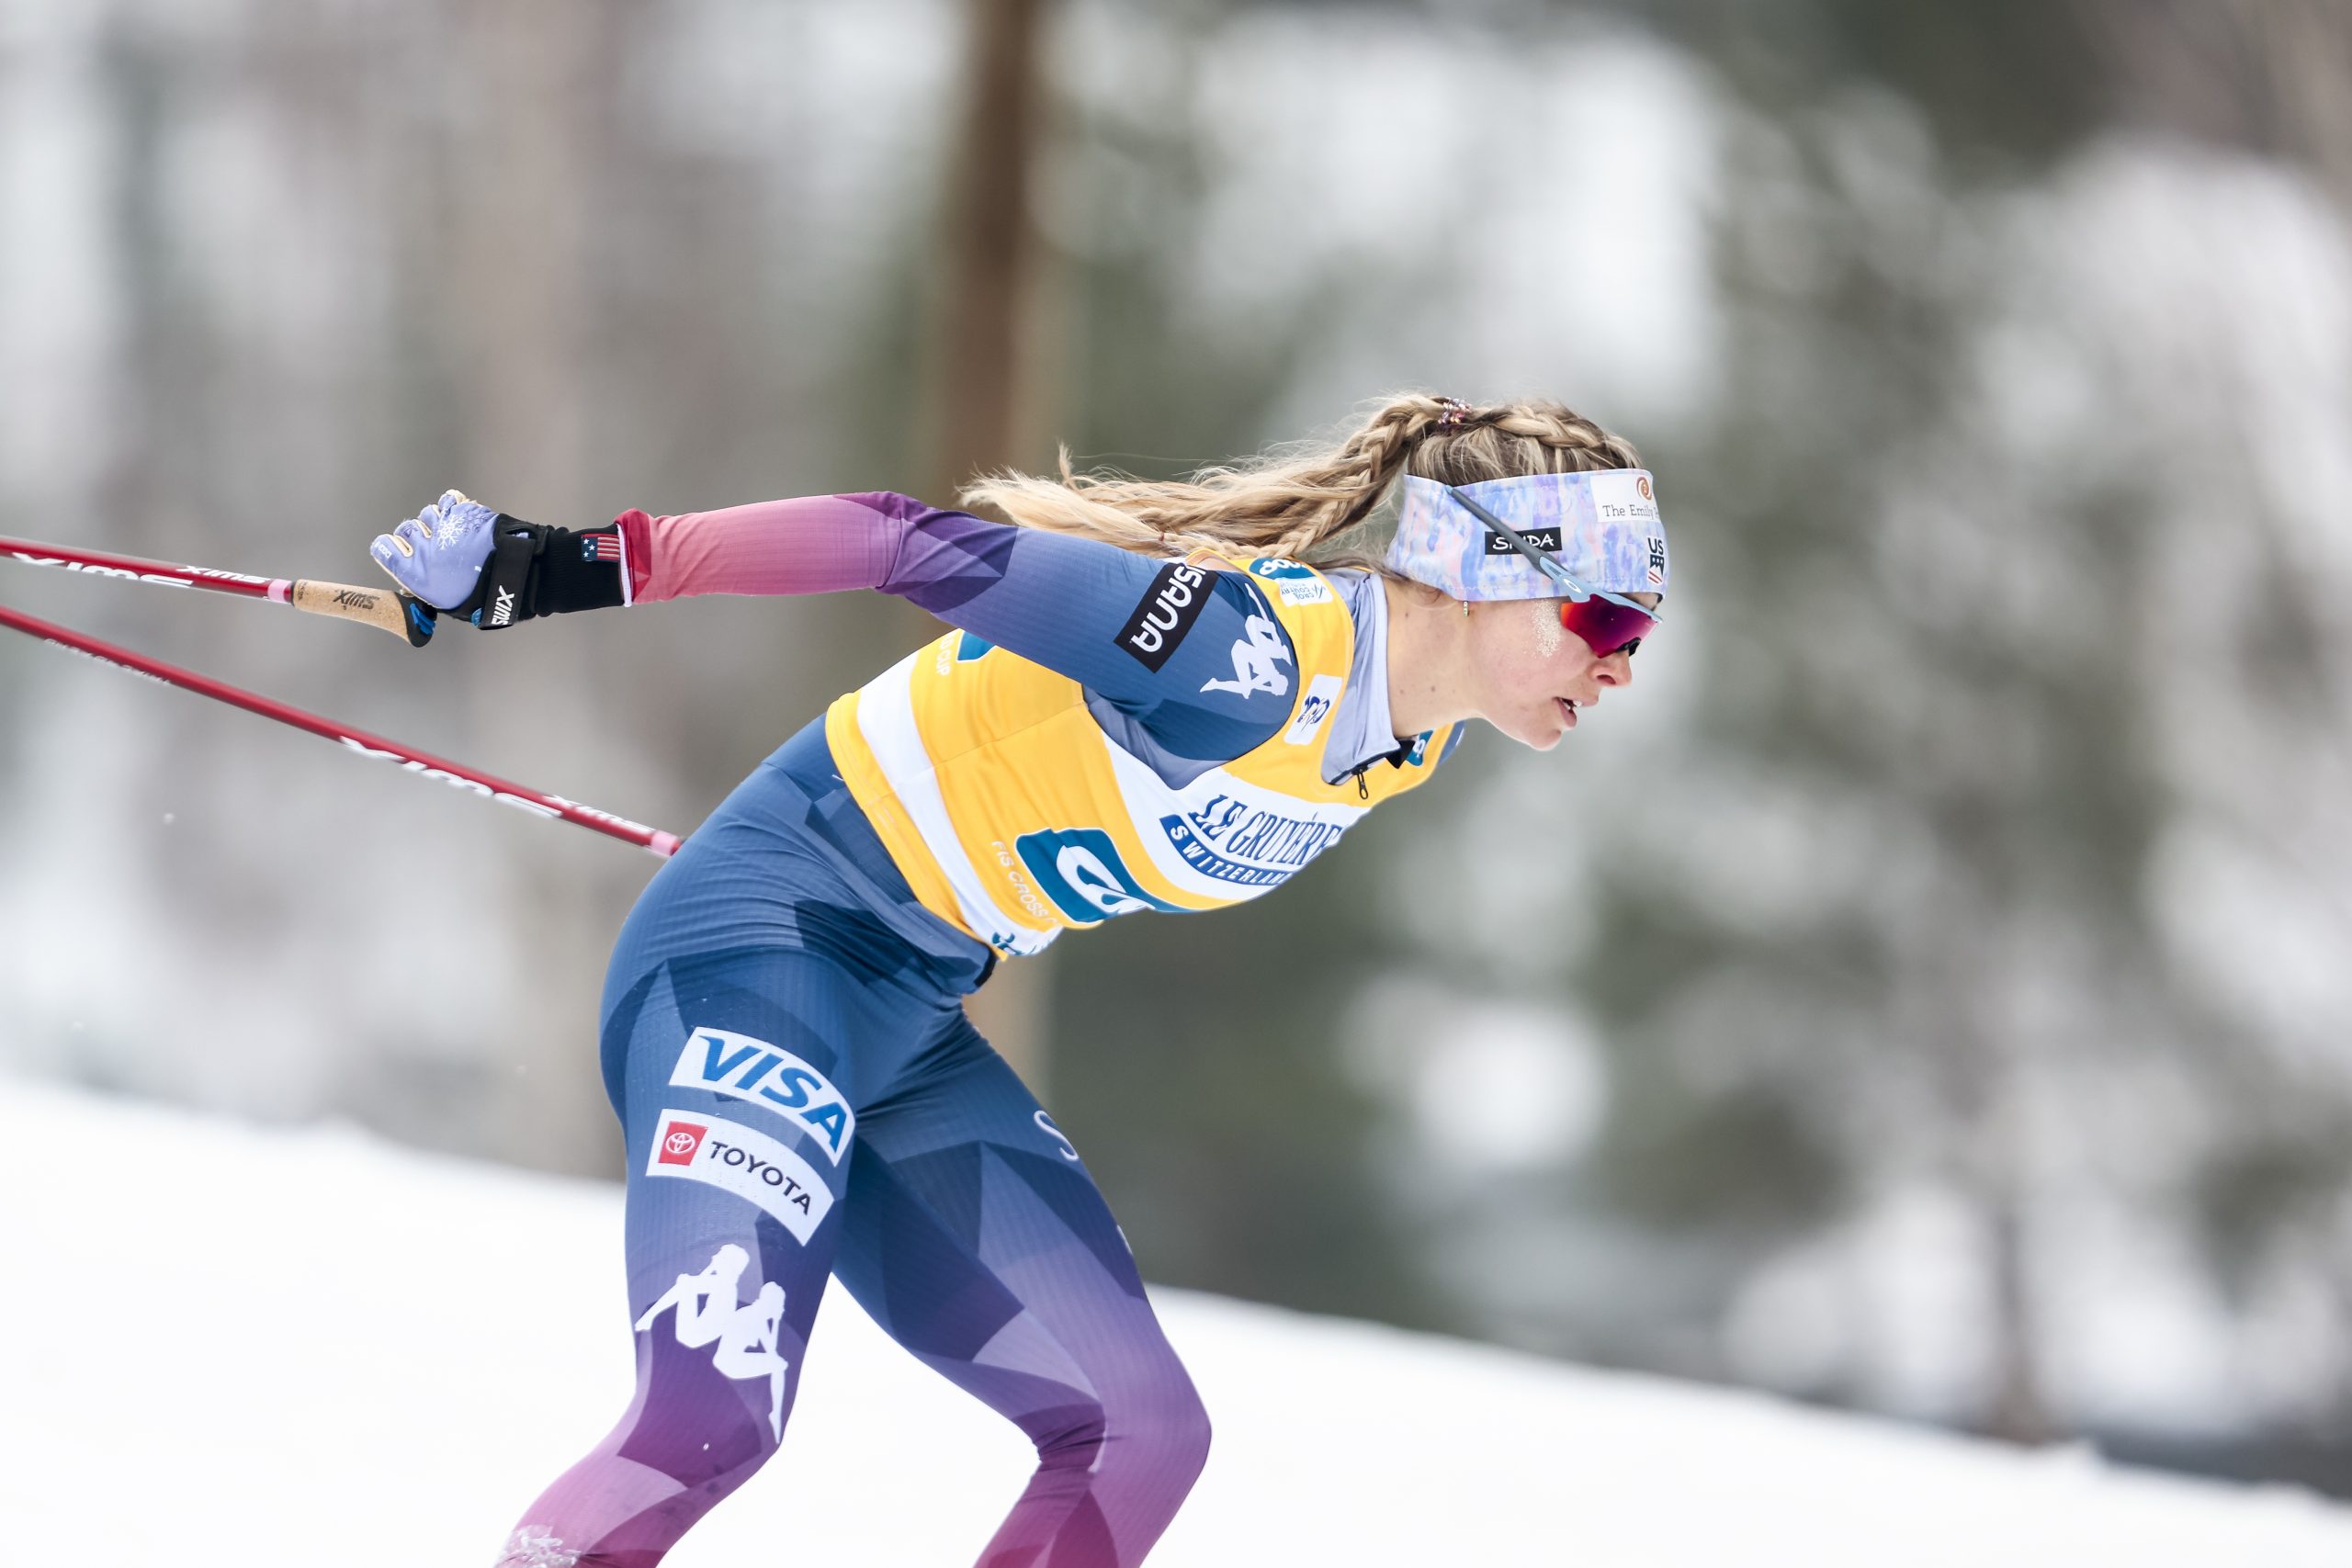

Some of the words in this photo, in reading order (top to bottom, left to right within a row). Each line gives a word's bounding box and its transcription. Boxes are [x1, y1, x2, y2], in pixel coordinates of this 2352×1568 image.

[1601, 503, 1625, 517] The
[1492, 534, 1555, 550] SDA
[1647, 536, 1664, 556] US
[1130, 564, 1206, 652] SANA
[1188, 794, 1248, 841] LE
[990, 840, 1015, 868] FIS
[1008, 870, 1049, 918] CROSS
[1170, 824, 1292, 886] SWITZERLAN
[697, 1034, 854, 1154] VISA
[709, 1139, 812, 1216] TOYOTA
